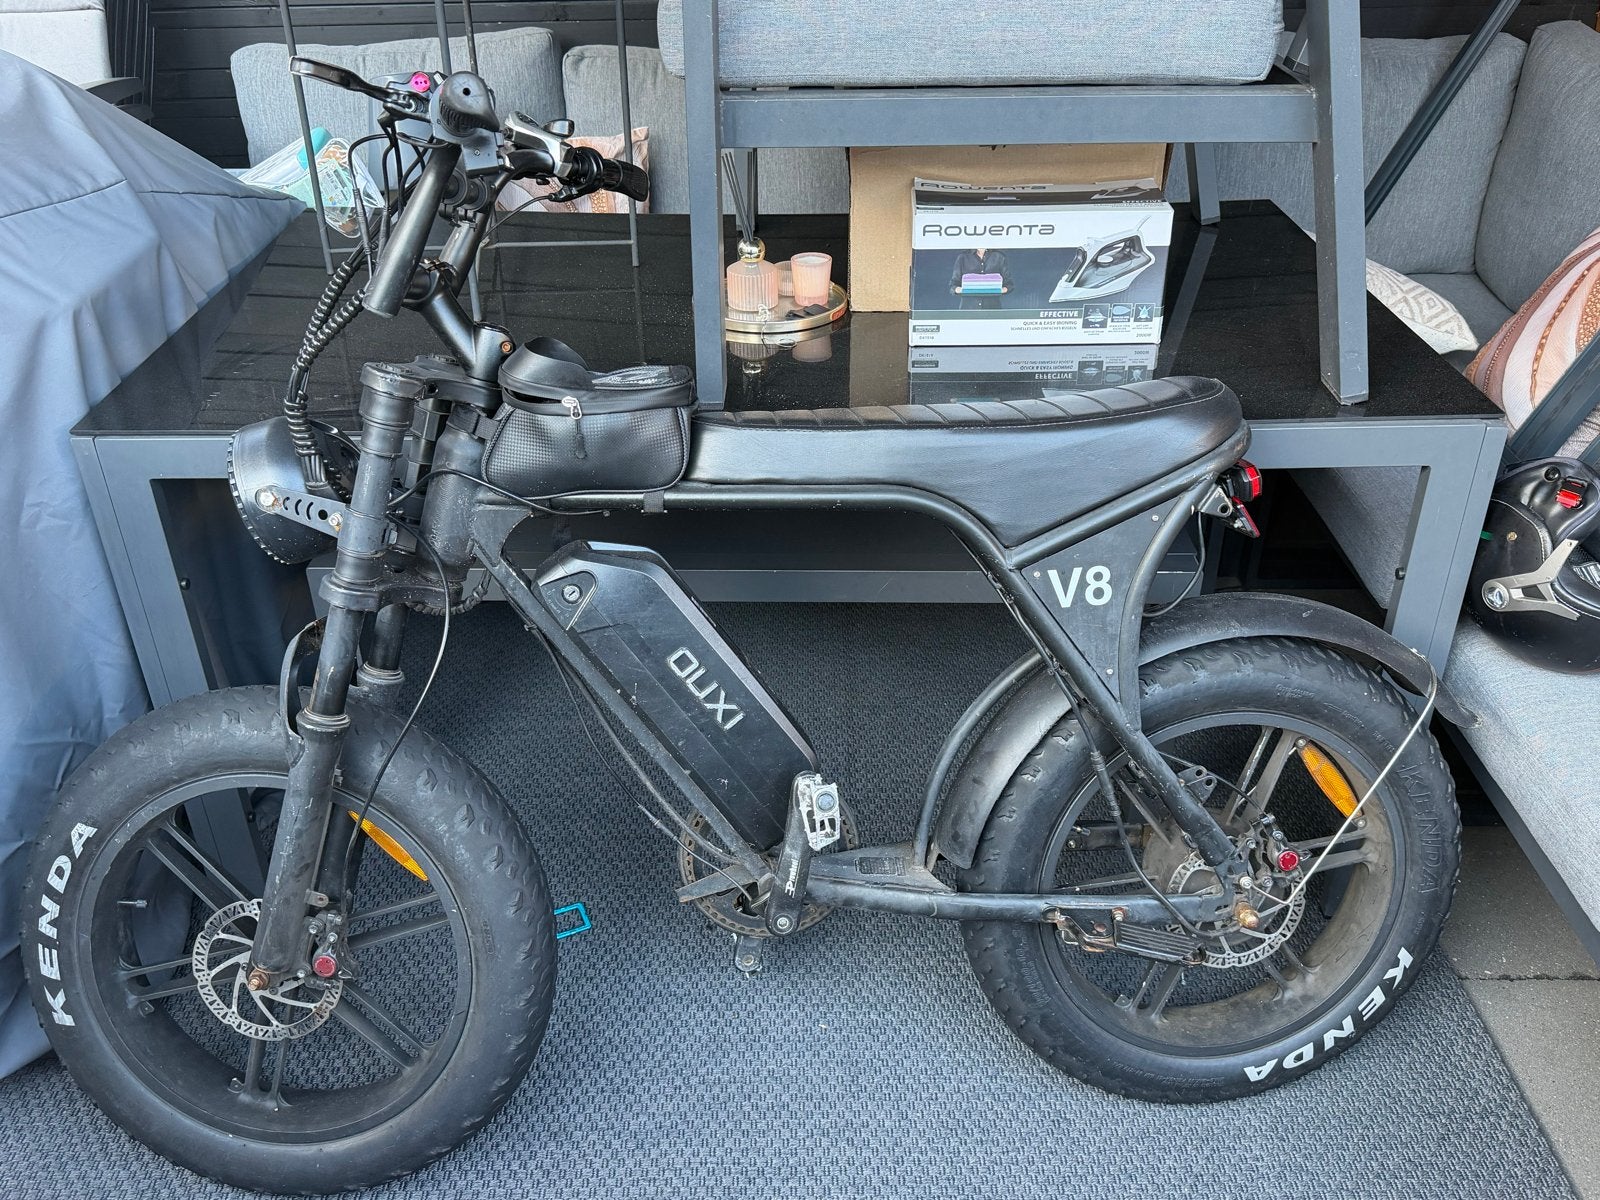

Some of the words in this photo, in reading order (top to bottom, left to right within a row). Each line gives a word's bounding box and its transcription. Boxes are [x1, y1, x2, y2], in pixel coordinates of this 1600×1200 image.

[1039, 310, 1079, 318] EFFECTIVE
[1048, 565, 1113, 608] V8
[666, 646, 747, 731] OUXI
[36, 821, 98, 1027] KENDA
[1243, 946, 1414, 1083] KENDA
